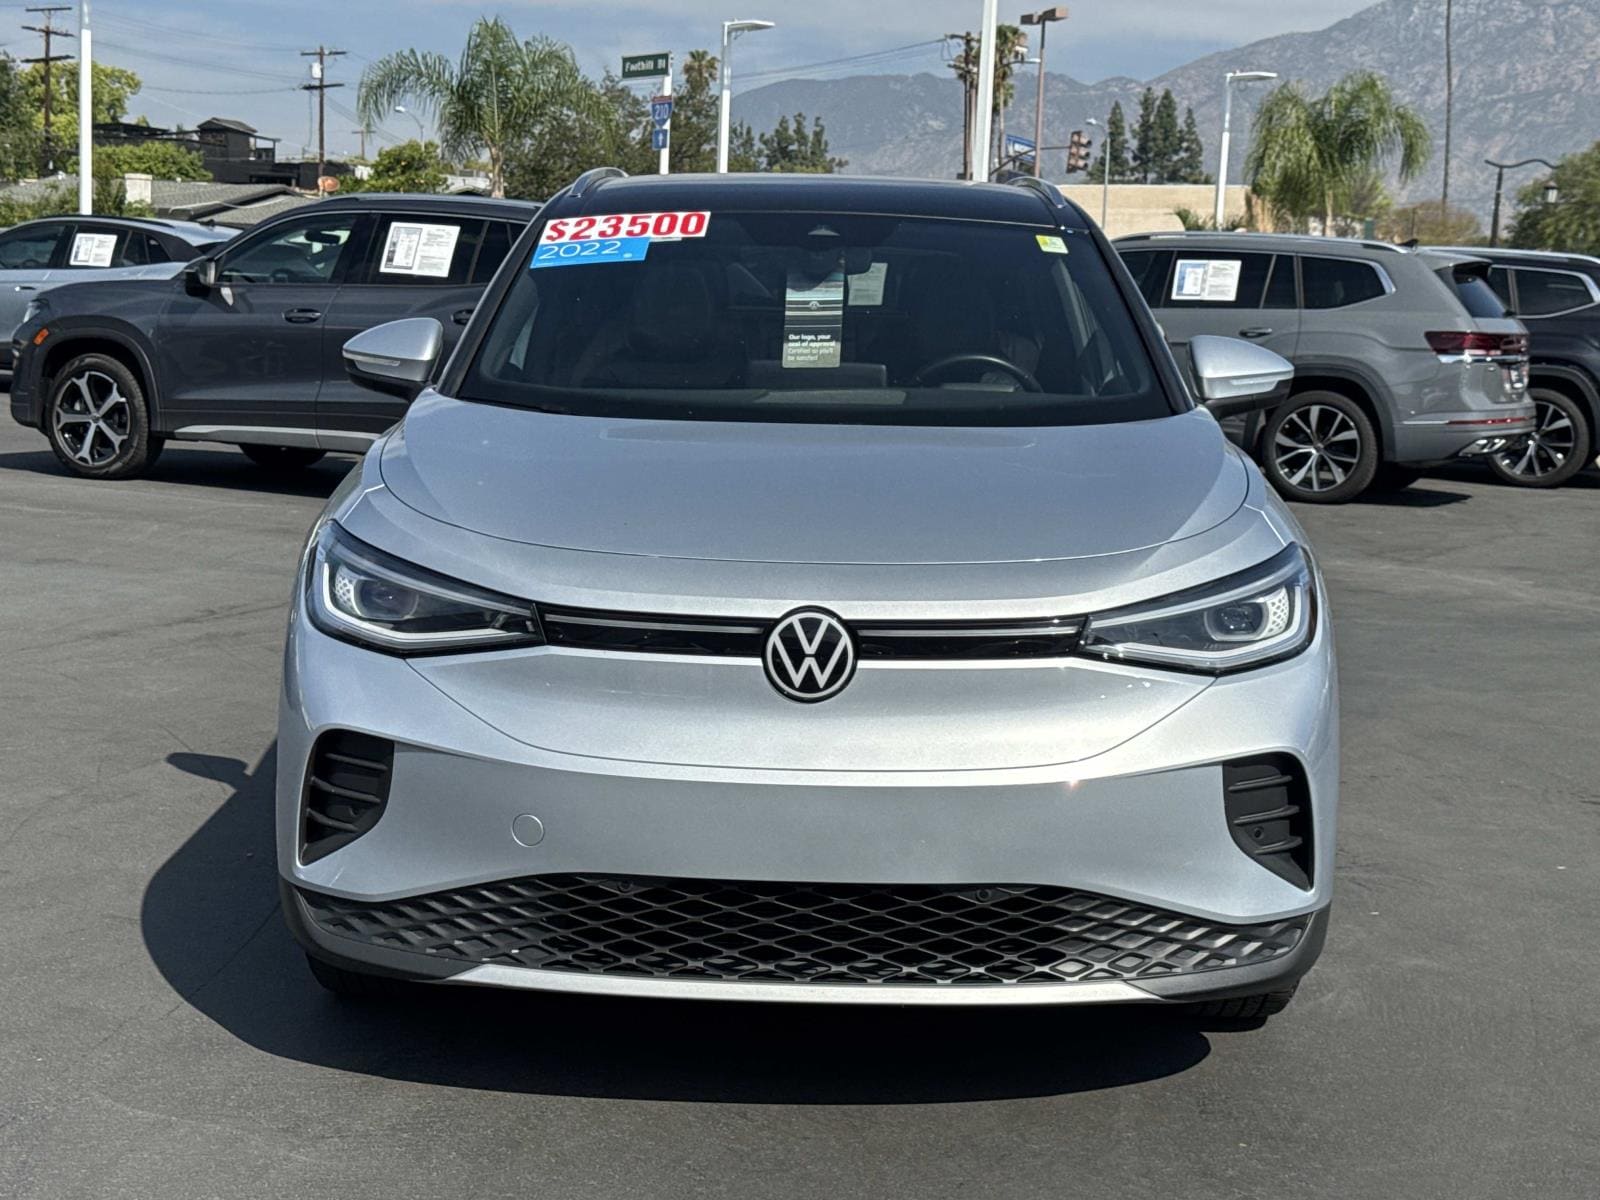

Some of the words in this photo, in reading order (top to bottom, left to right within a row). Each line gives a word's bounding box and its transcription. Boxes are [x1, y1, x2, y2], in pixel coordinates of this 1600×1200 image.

[655, 103, 669, 120] 210
[546, 213, 706, 241] $23500
[538, 240, 621, 259] 2022
[767, 612, 853, 697] VW
